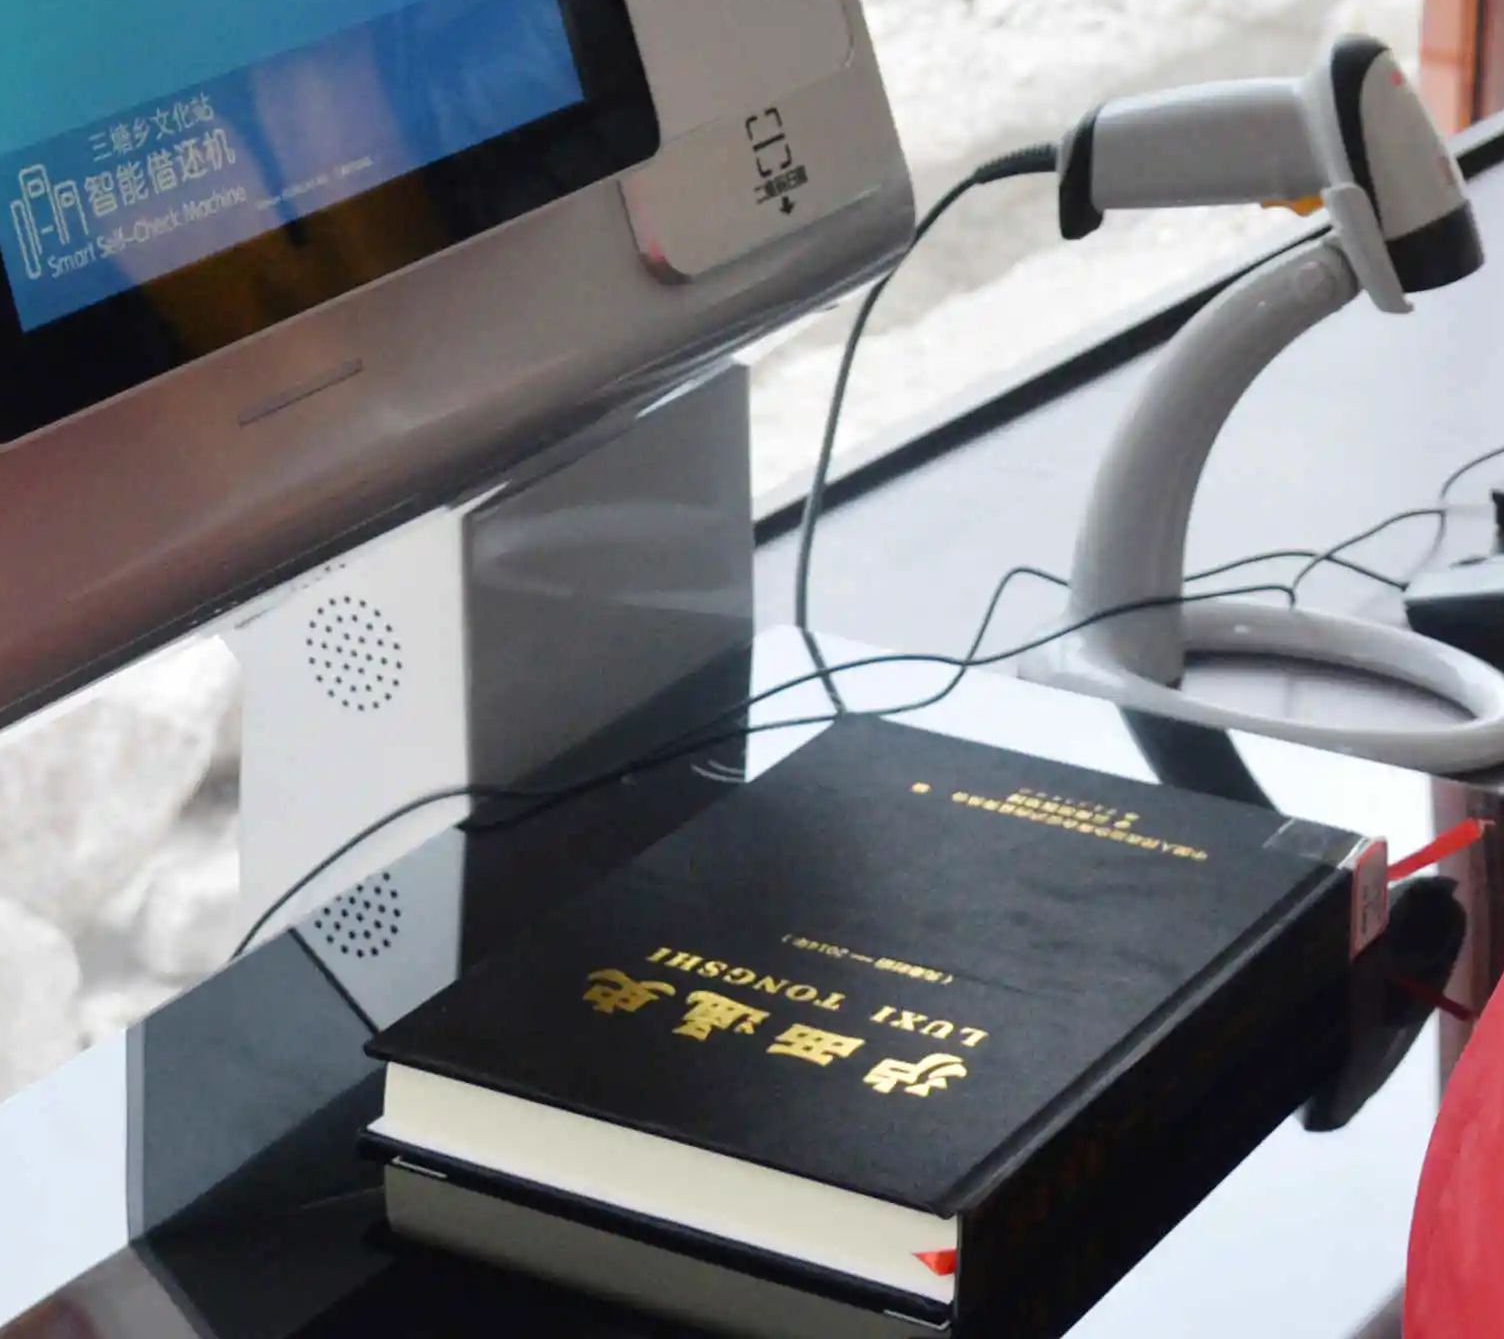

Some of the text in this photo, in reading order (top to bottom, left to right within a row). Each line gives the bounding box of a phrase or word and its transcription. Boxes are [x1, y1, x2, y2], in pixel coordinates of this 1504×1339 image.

[82, 127, 237, 219] 智能借还机
[89, 91, 215, 163] 三塘乡文化站
[46, 244, 96, 279] Smart
[96, 209, 179, 260] Self-Check
[181, 183, 248, 224] Machine
[582, 967, 969, 1099] 泸西通史
[645, 946, 989, 1048] LUXI TONGSHI
